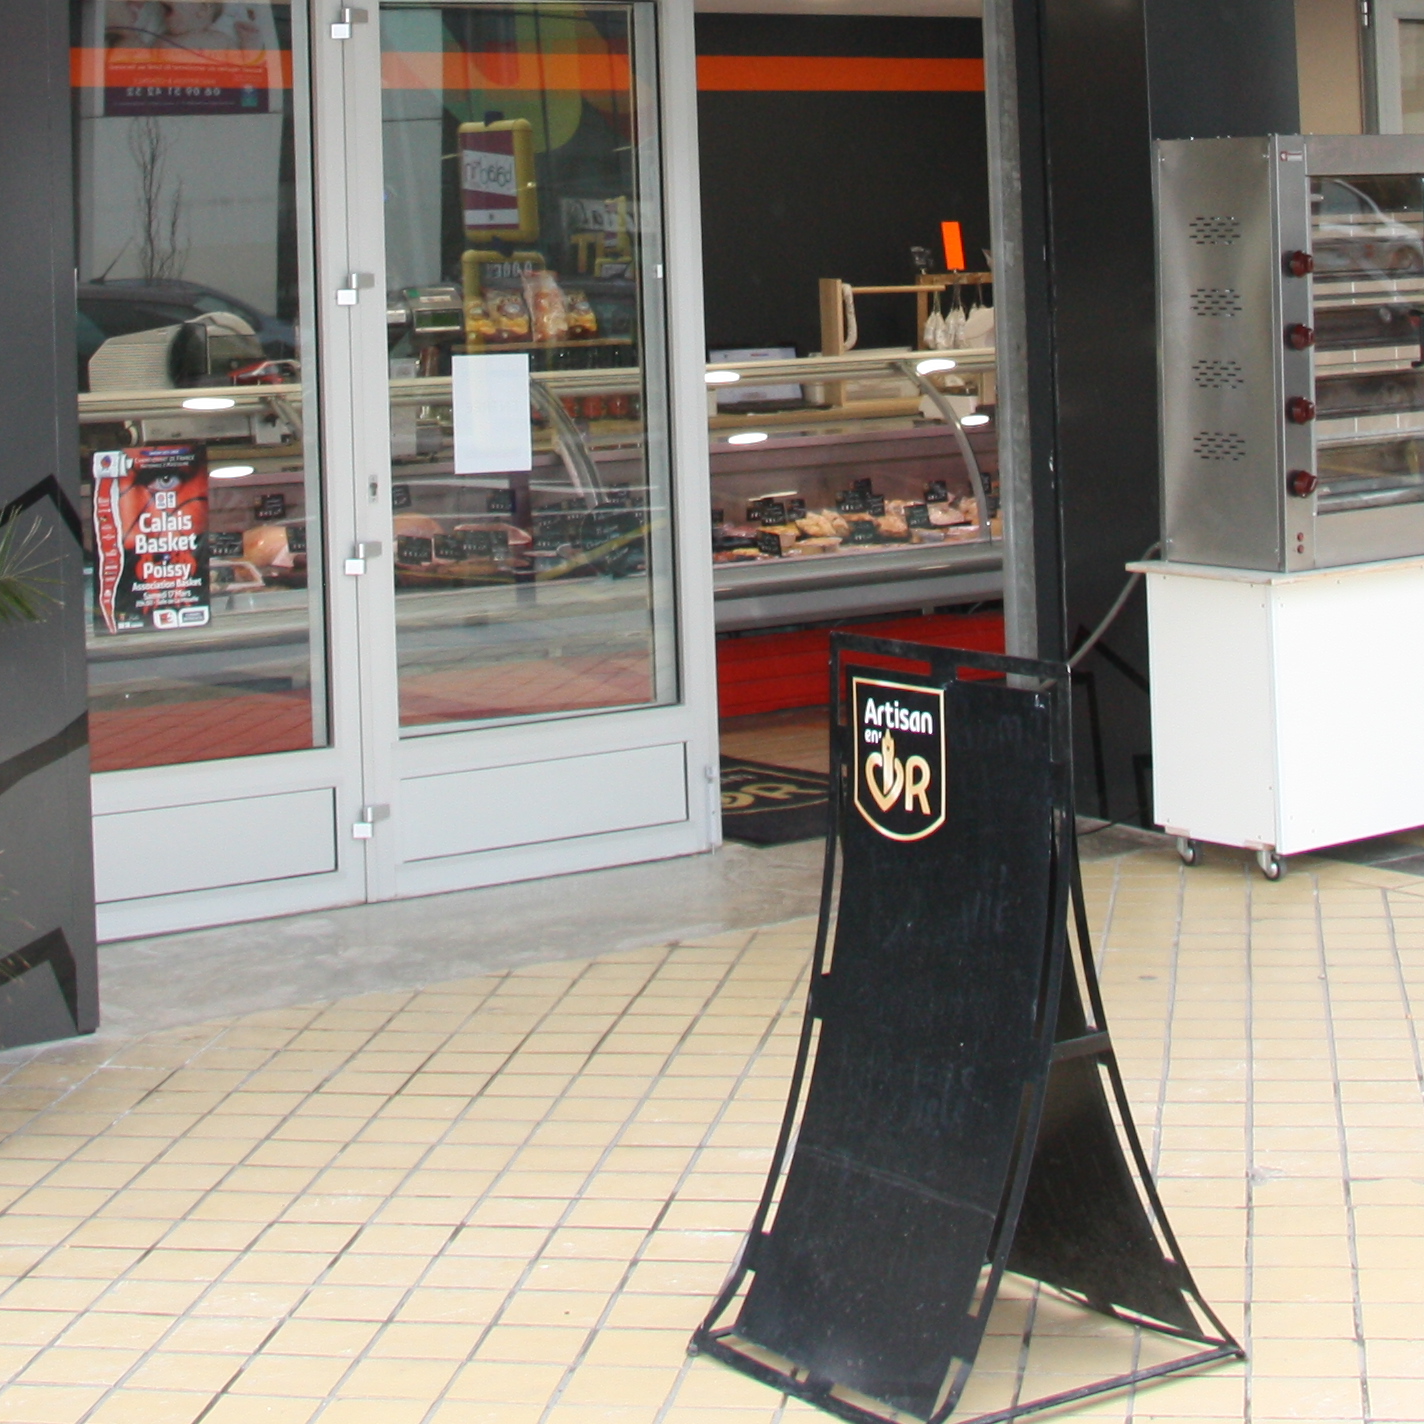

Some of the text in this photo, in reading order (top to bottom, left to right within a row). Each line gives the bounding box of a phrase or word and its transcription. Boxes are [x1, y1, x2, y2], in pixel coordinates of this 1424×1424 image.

[138, 510, 192, 533] Calais
[135, 532, 198, 555] Basket
[143, 560, 192, 580] Poissy
[132, 577, 203, 592] Association Basket
[864, 697, 934, 735] Artisan
